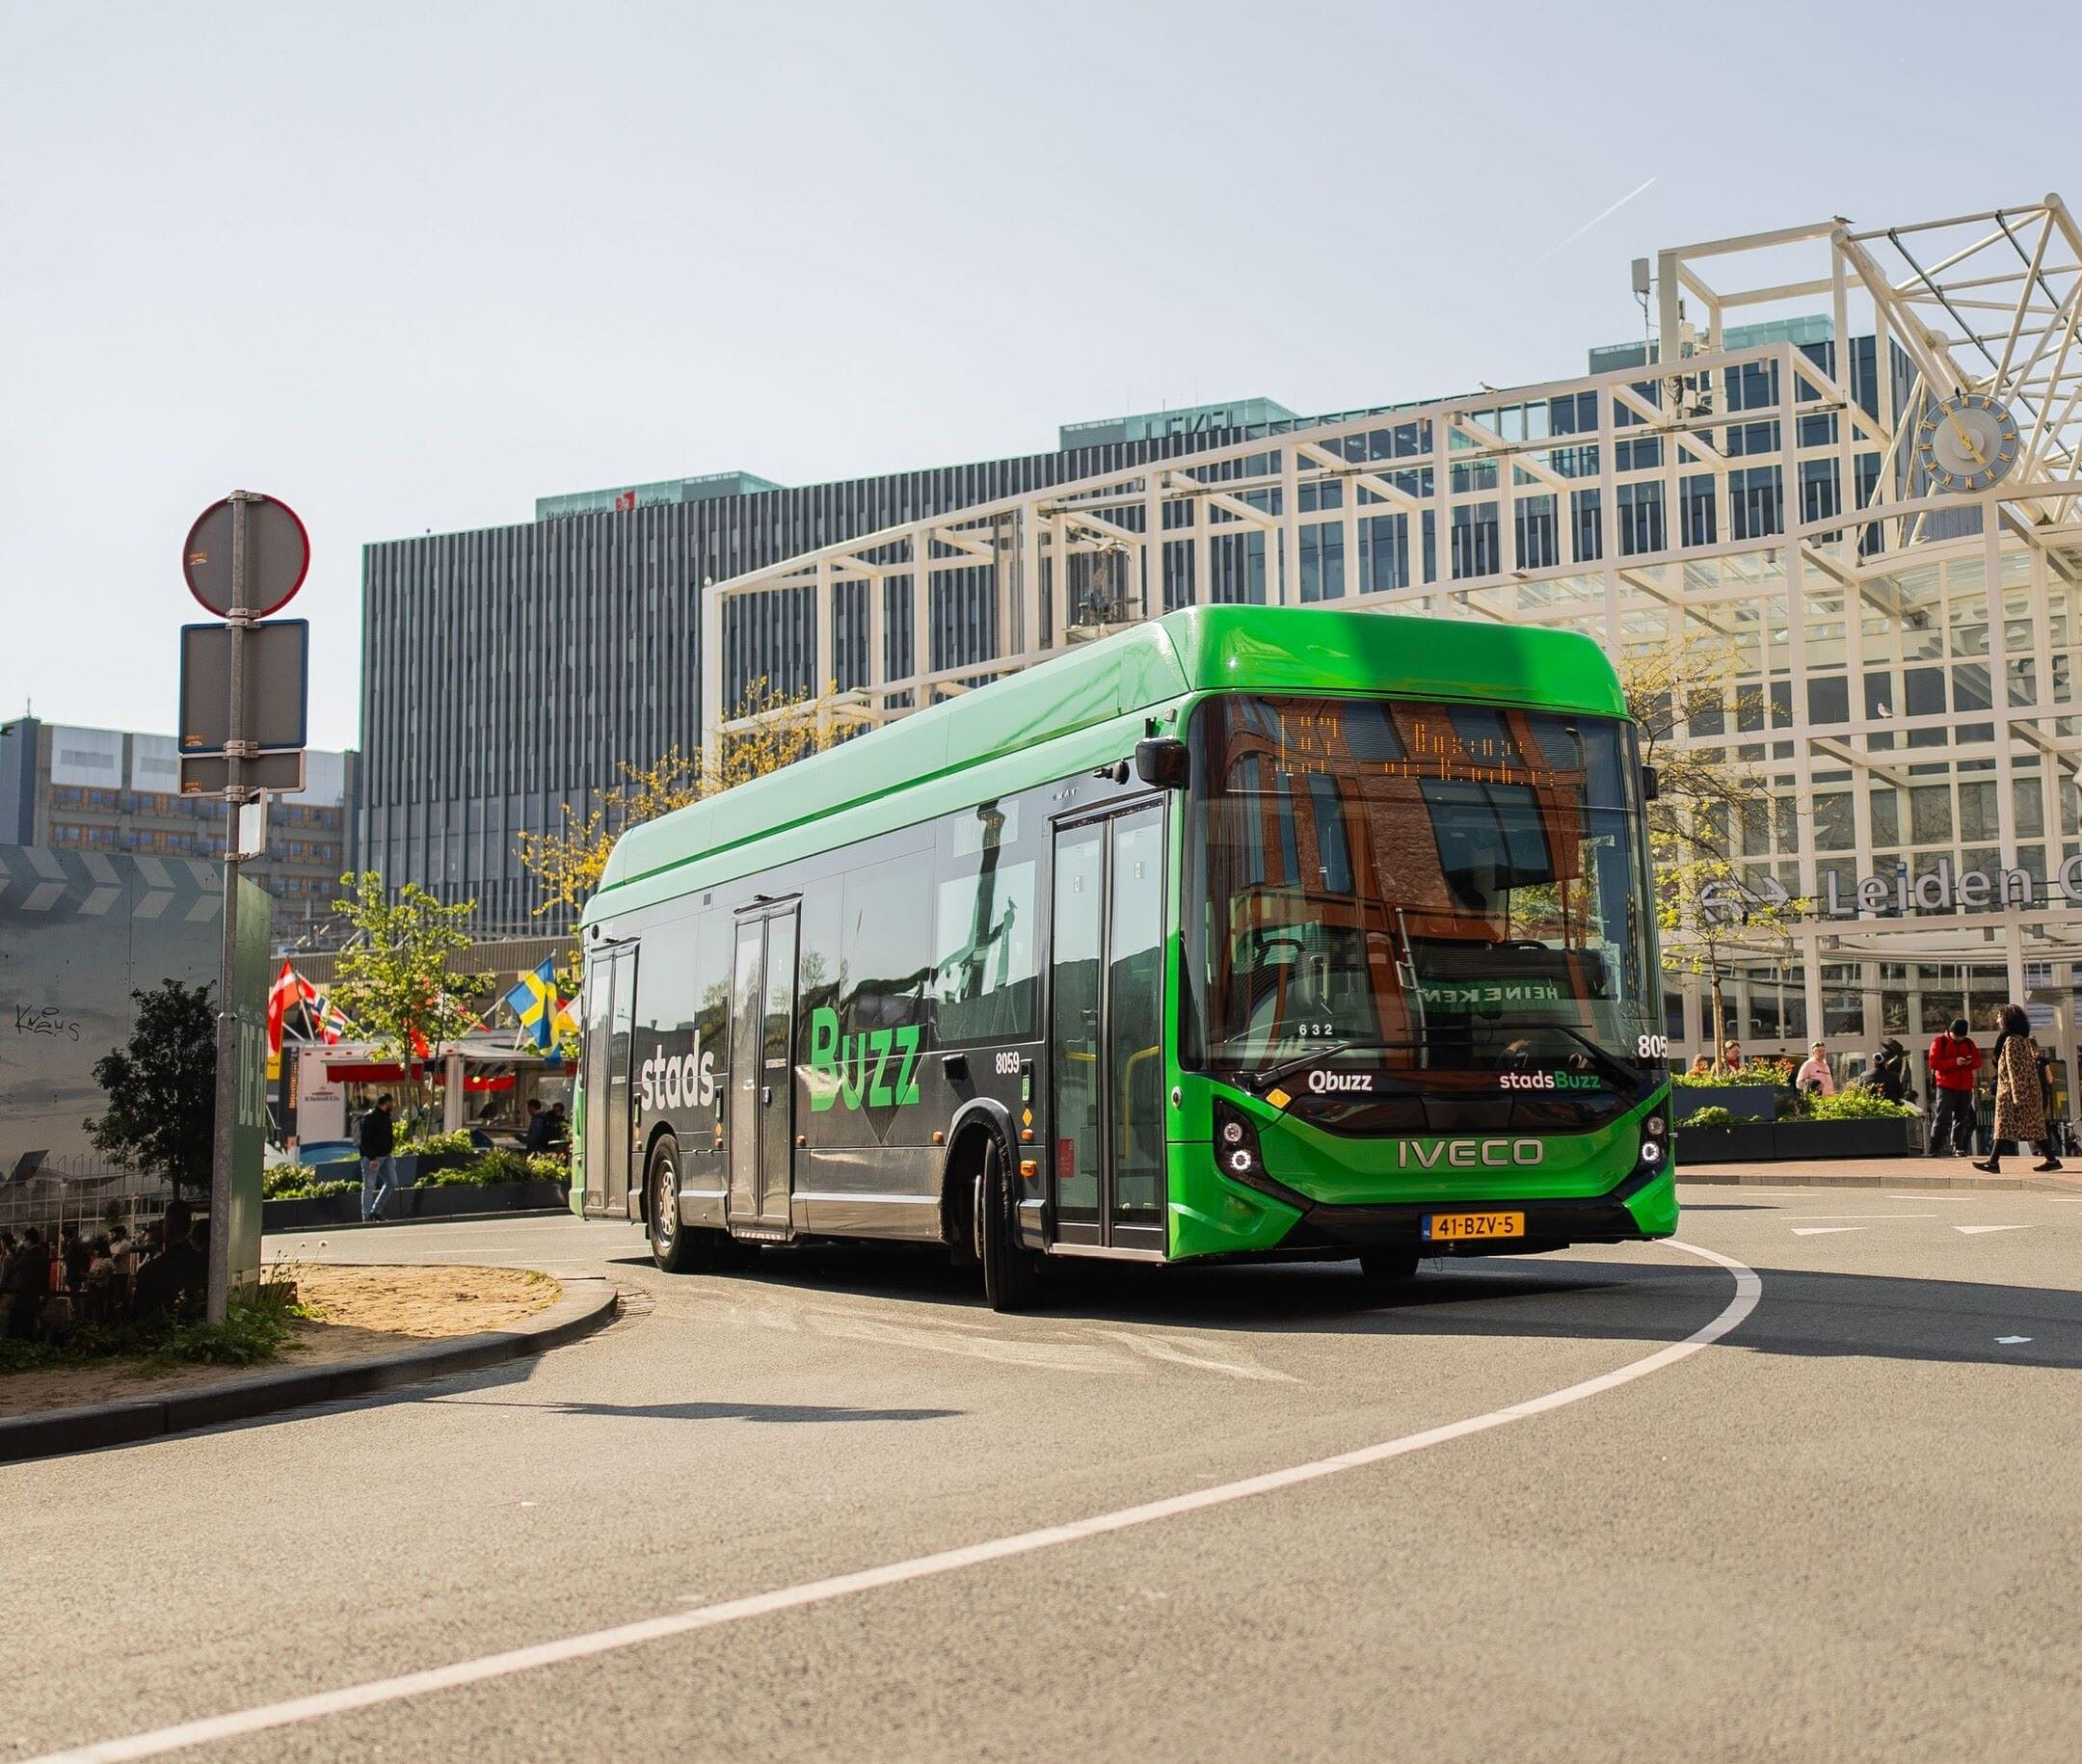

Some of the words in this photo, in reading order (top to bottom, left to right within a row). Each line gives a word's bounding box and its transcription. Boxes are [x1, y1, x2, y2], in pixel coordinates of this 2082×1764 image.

[1827, 857, 2033, 915] Leiden
[641, 1029, 714, 1111] stads
[996, 1051, 1020, 1075] 8059
[1308, 1070, 1374, 1094] Qbuzz
[1500, 1070, 1601, 1090] stadsBuzz
[1399, 1138, 1543, 1168] IVECO
[1438, 1216, 1514, 1236] 41-BZV-5
